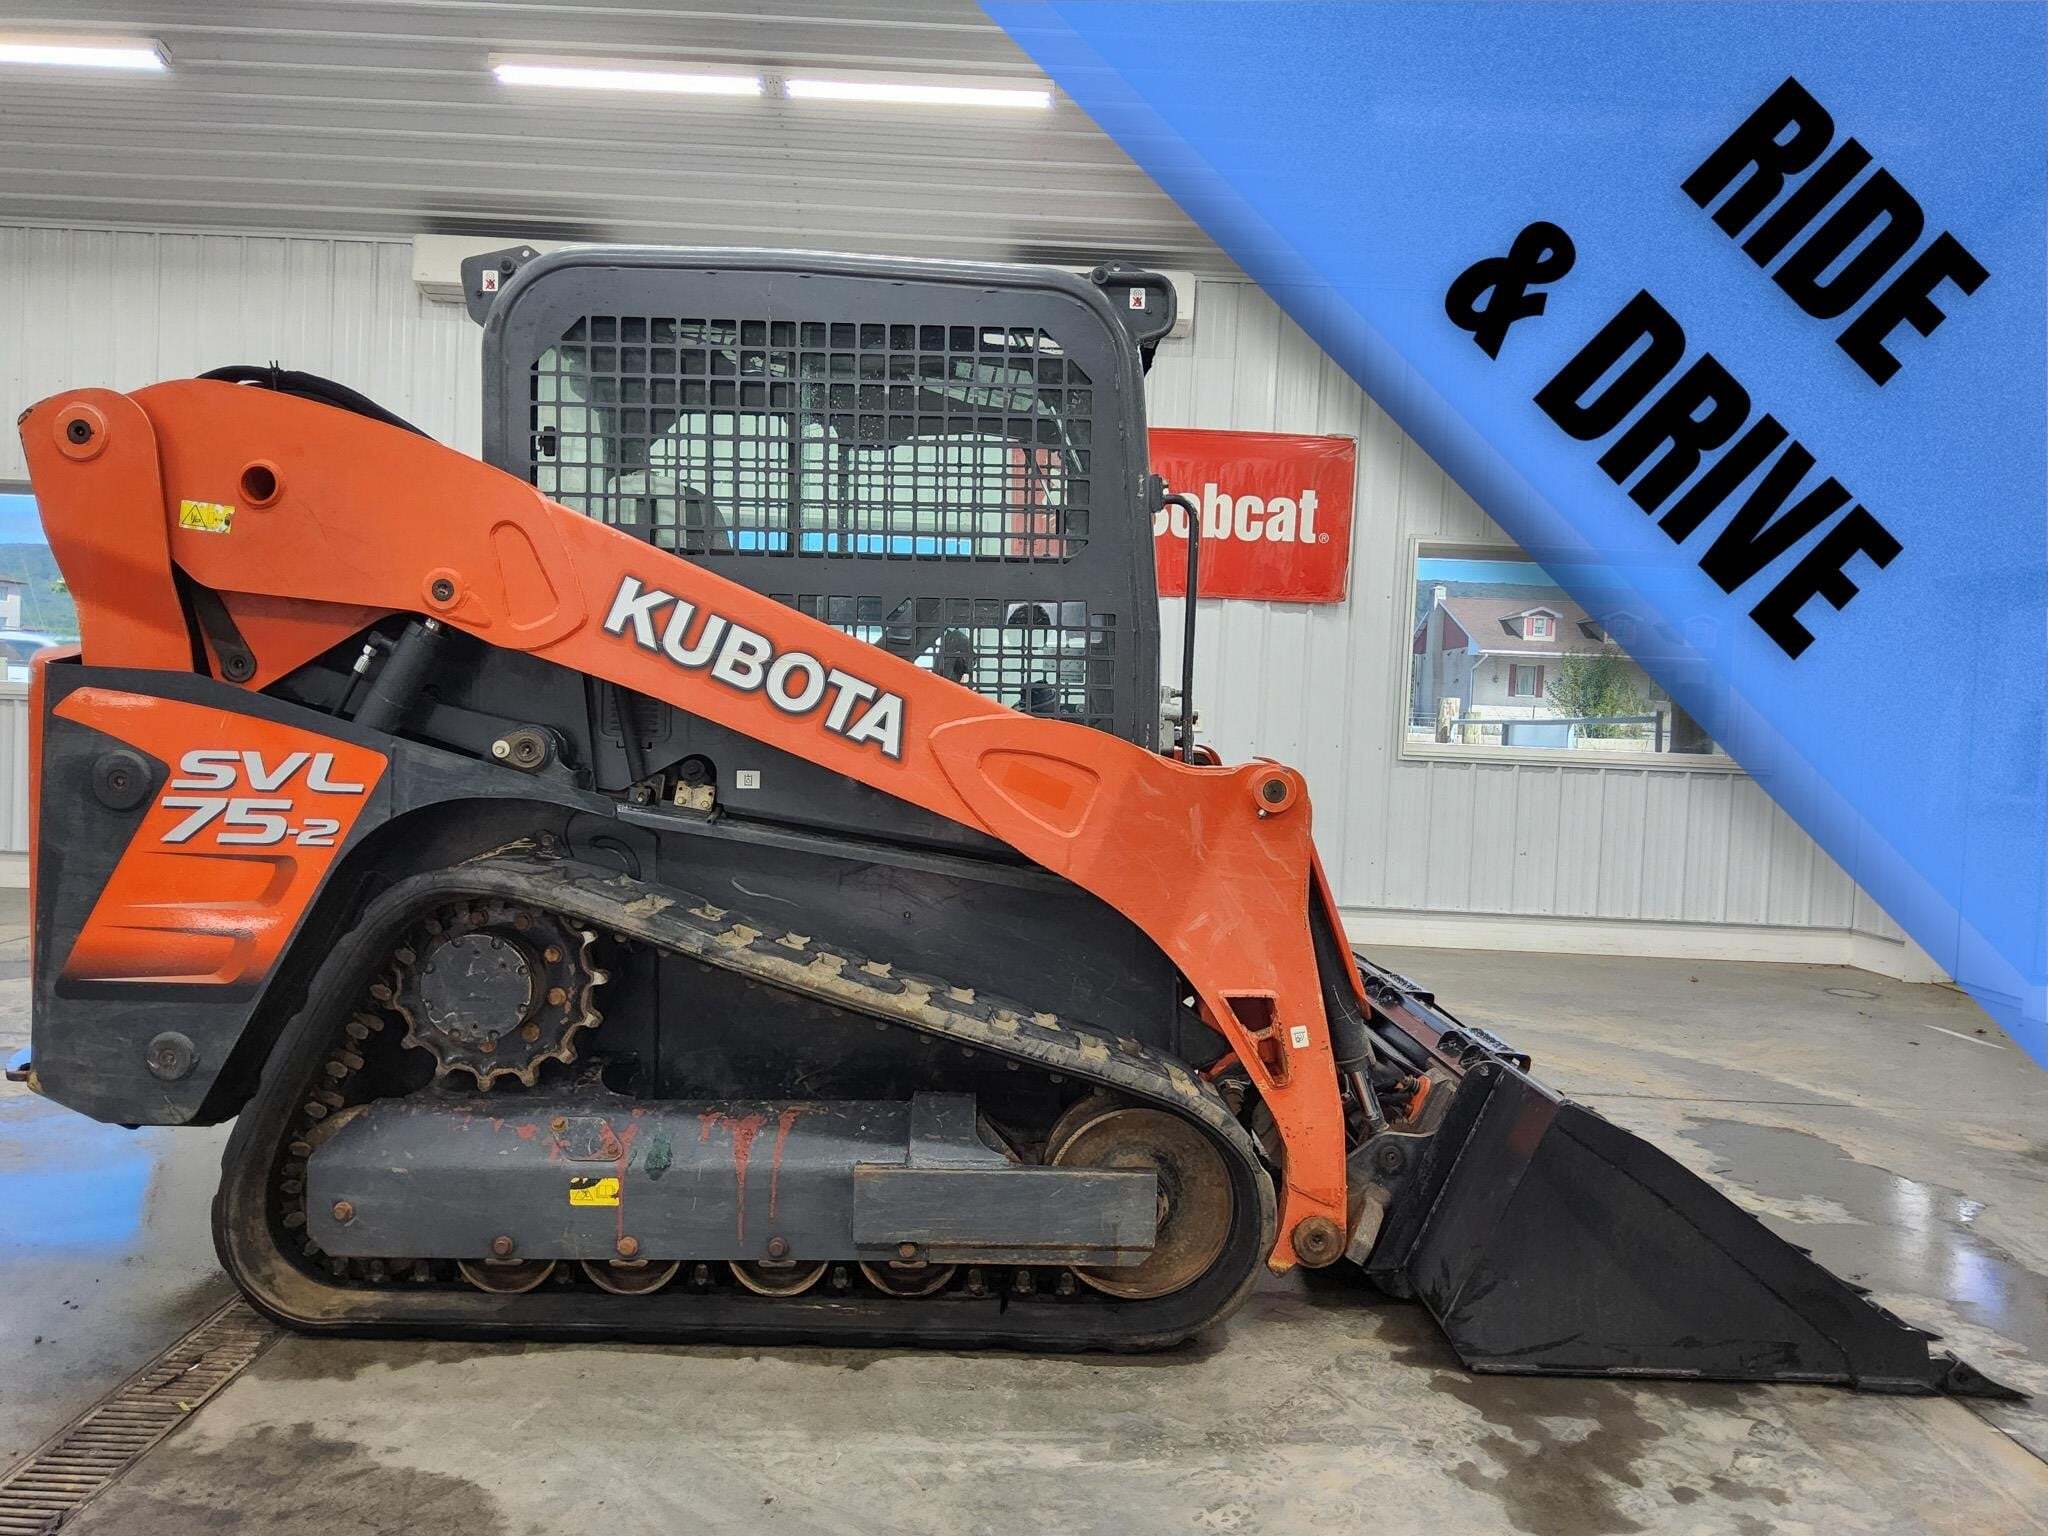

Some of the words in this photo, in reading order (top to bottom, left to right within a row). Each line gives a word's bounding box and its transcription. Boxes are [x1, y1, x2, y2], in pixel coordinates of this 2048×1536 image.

[603, 575, 903, 759] KUBOTA
[170, 750, 365, 793] SVL
[160, 796, 340, 845] 75-2
